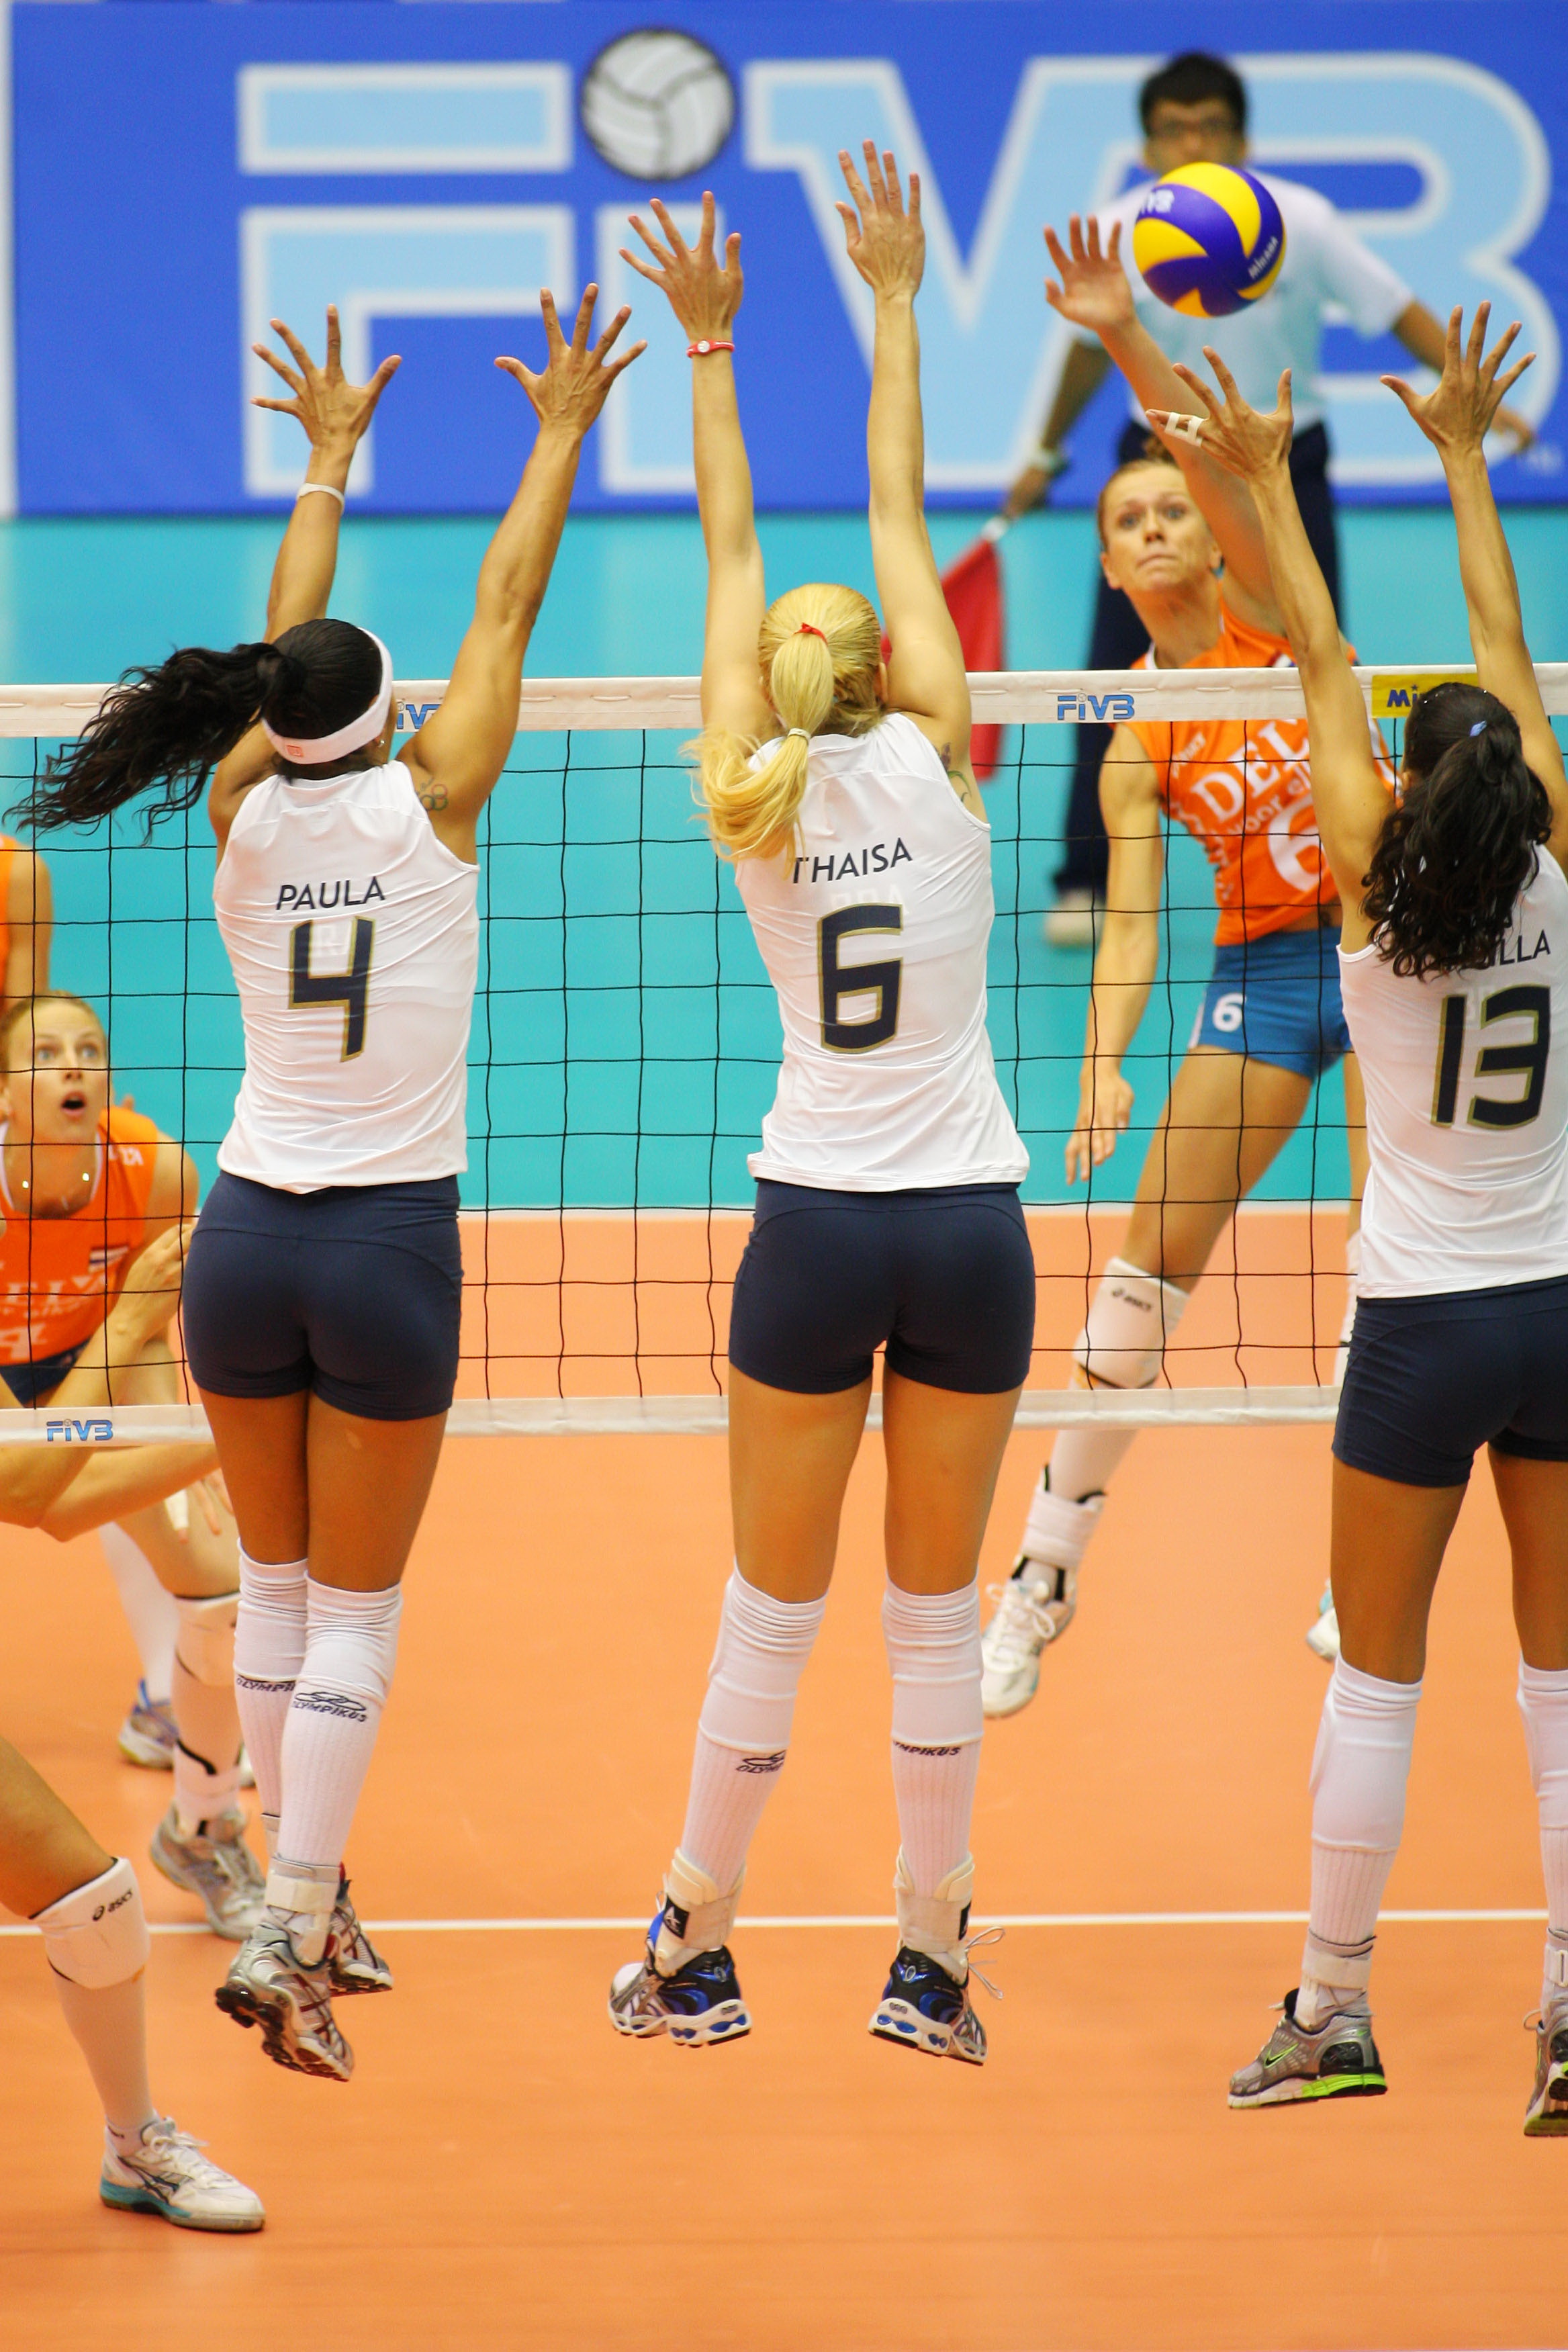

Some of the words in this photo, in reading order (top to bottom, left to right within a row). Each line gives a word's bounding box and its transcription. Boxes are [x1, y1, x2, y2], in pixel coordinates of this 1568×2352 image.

[1189, 719, 1309, 823] DEL
[275, 876, 386, 911] PAULA
[792, 838, 913, 883] THAISA
[288, 915, 376, 1062] 4
[817, 903, 903, 1054] 6
[1213, 992, 1247, 1032] 6
[1430, 983, 1551, 1130] 13
